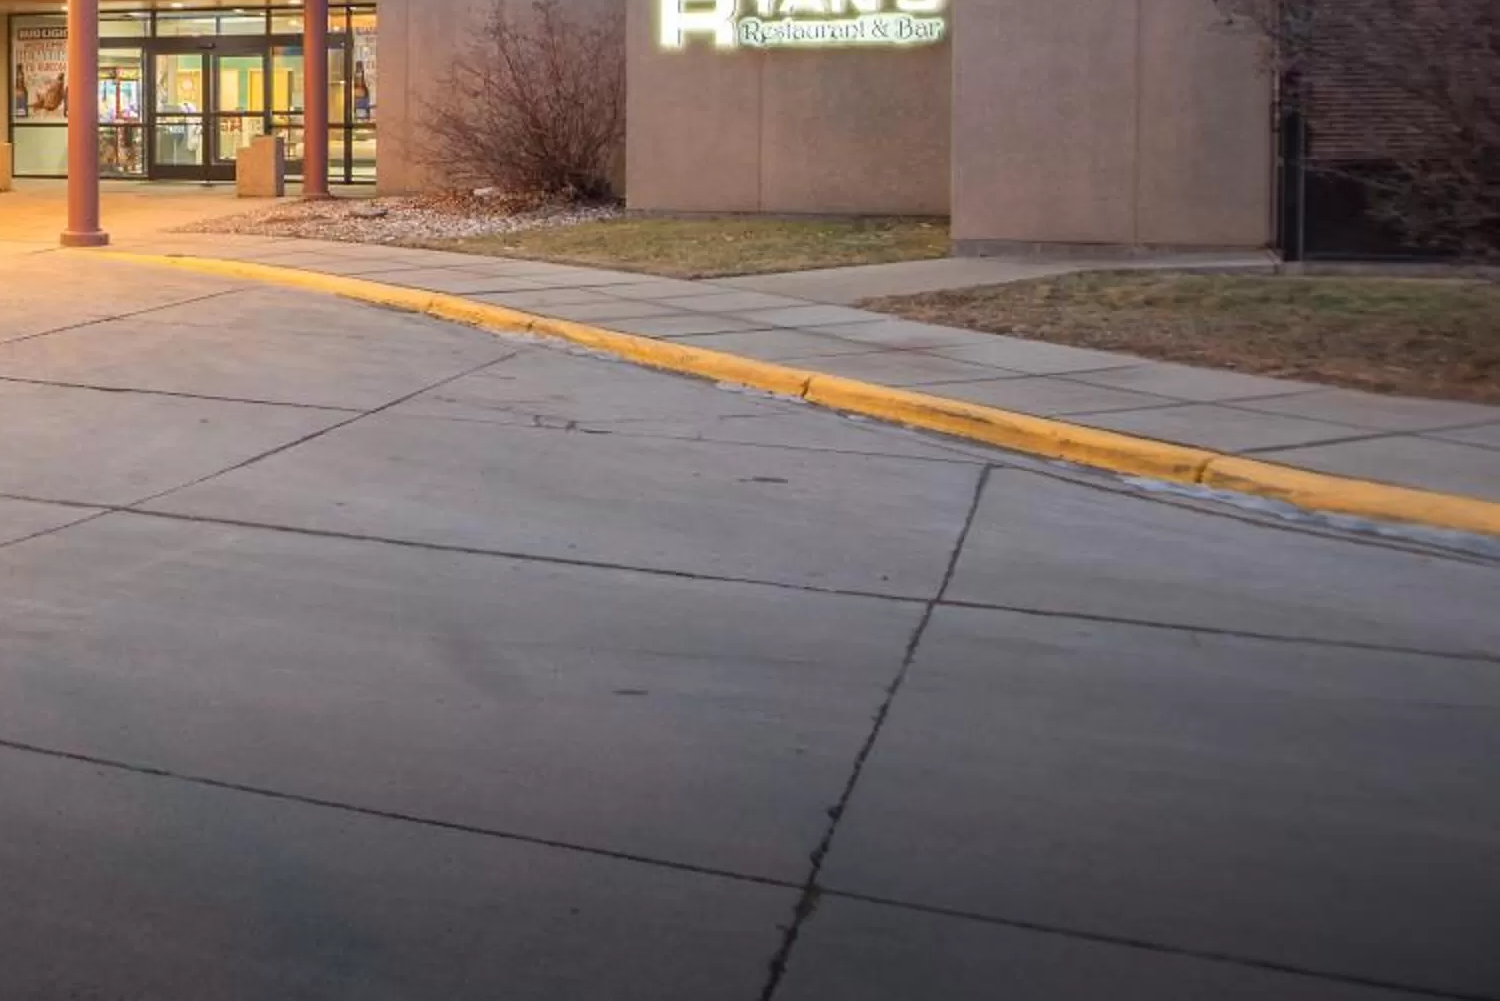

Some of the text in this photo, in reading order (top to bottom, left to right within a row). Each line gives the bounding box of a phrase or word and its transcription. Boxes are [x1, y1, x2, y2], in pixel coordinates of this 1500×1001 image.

[743, 17, 943, 43] Restaurant & Bar
